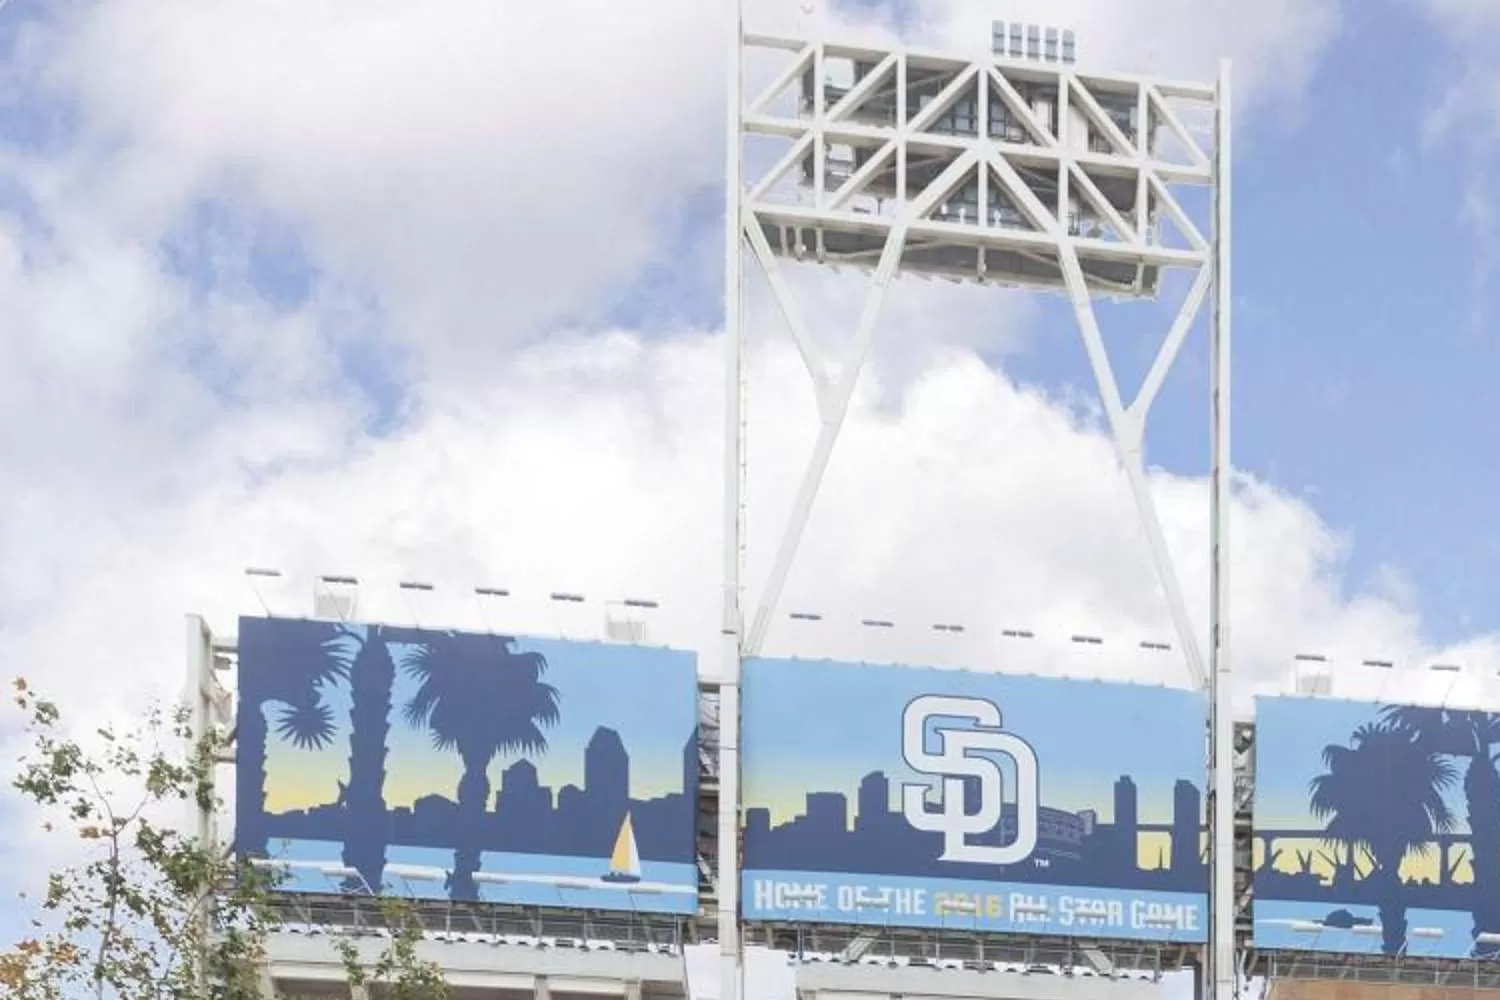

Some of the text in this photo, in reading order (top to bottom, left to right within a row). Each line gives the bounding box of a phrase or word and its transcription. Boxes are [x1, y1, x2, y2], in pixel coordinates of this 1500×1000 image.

[902, 693, 1039, 865] SD
[754, 879, 828, 911] HOME
[838, 885, 867, 912] OF
[879, 887, 927, 914] THE
[933, 891, 1001, 918] 2016
[1058, 895, 1124, 927] STAR
[1131, 898, 1200, 931] GAME
